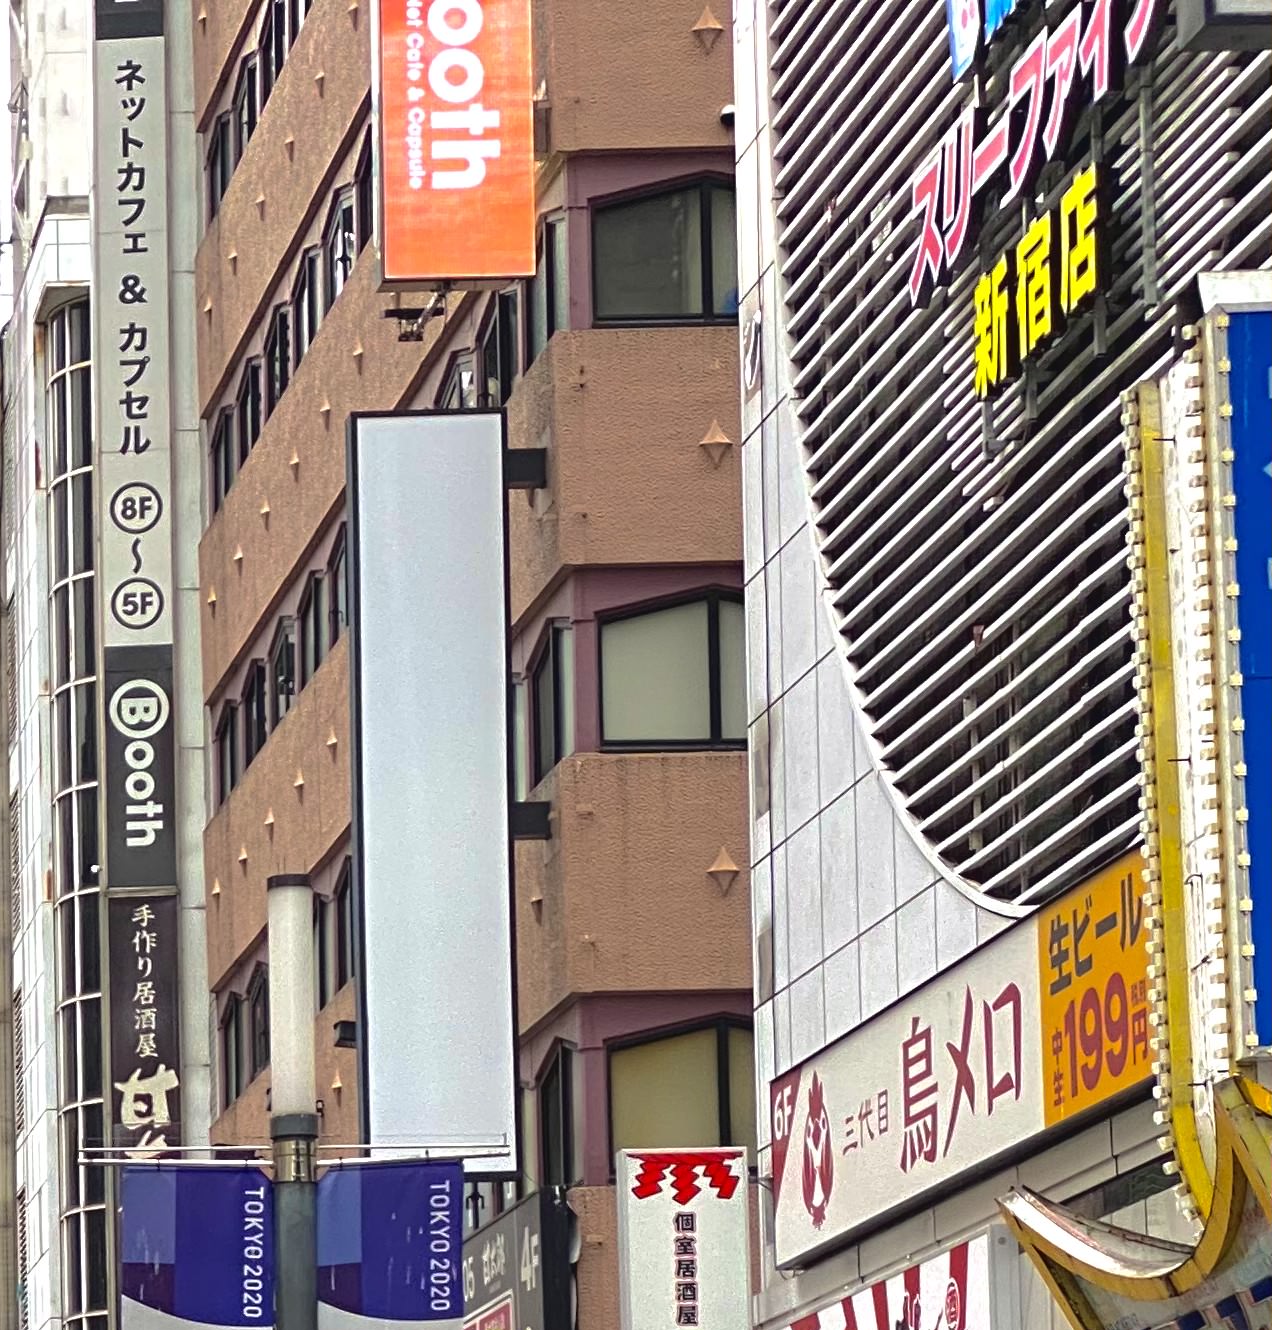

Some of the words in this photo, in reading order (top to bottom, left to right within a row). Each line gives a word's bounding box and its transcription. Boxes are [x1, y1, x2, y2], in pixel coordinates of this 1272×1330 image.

[115, 60, 149, 254] ネットカフェ
[118, 275, 148, 304] &
[973, 163, 1099, 398] 新宿店
[118, 323, 151, 456] カプセル
[120, 496, 153, 520] 8F
[121, 592, 154, 616] 5F
[109, 679, 170, 848] Booth
[1048, 872, 1145, 997] 生ビール
[131, 903, 159, 1058] 手作り居酒屋
[773, 1083, 794, 1143] 6F
[899, 982, 1023, 1174] 鳥メロ
[841, 1089, 889, 1157] 三代目
[243, 1186, 264, 1259] TOKYO
[429, 1179, 451, 1253] TOKYO
[243, 1263, 264, 1319] 2020
[429, 1256, 451, 1312] 2020
[519, 1226, 540, 1292] 4F
[673, 1210, 700, 1328] 個室居酒屋
